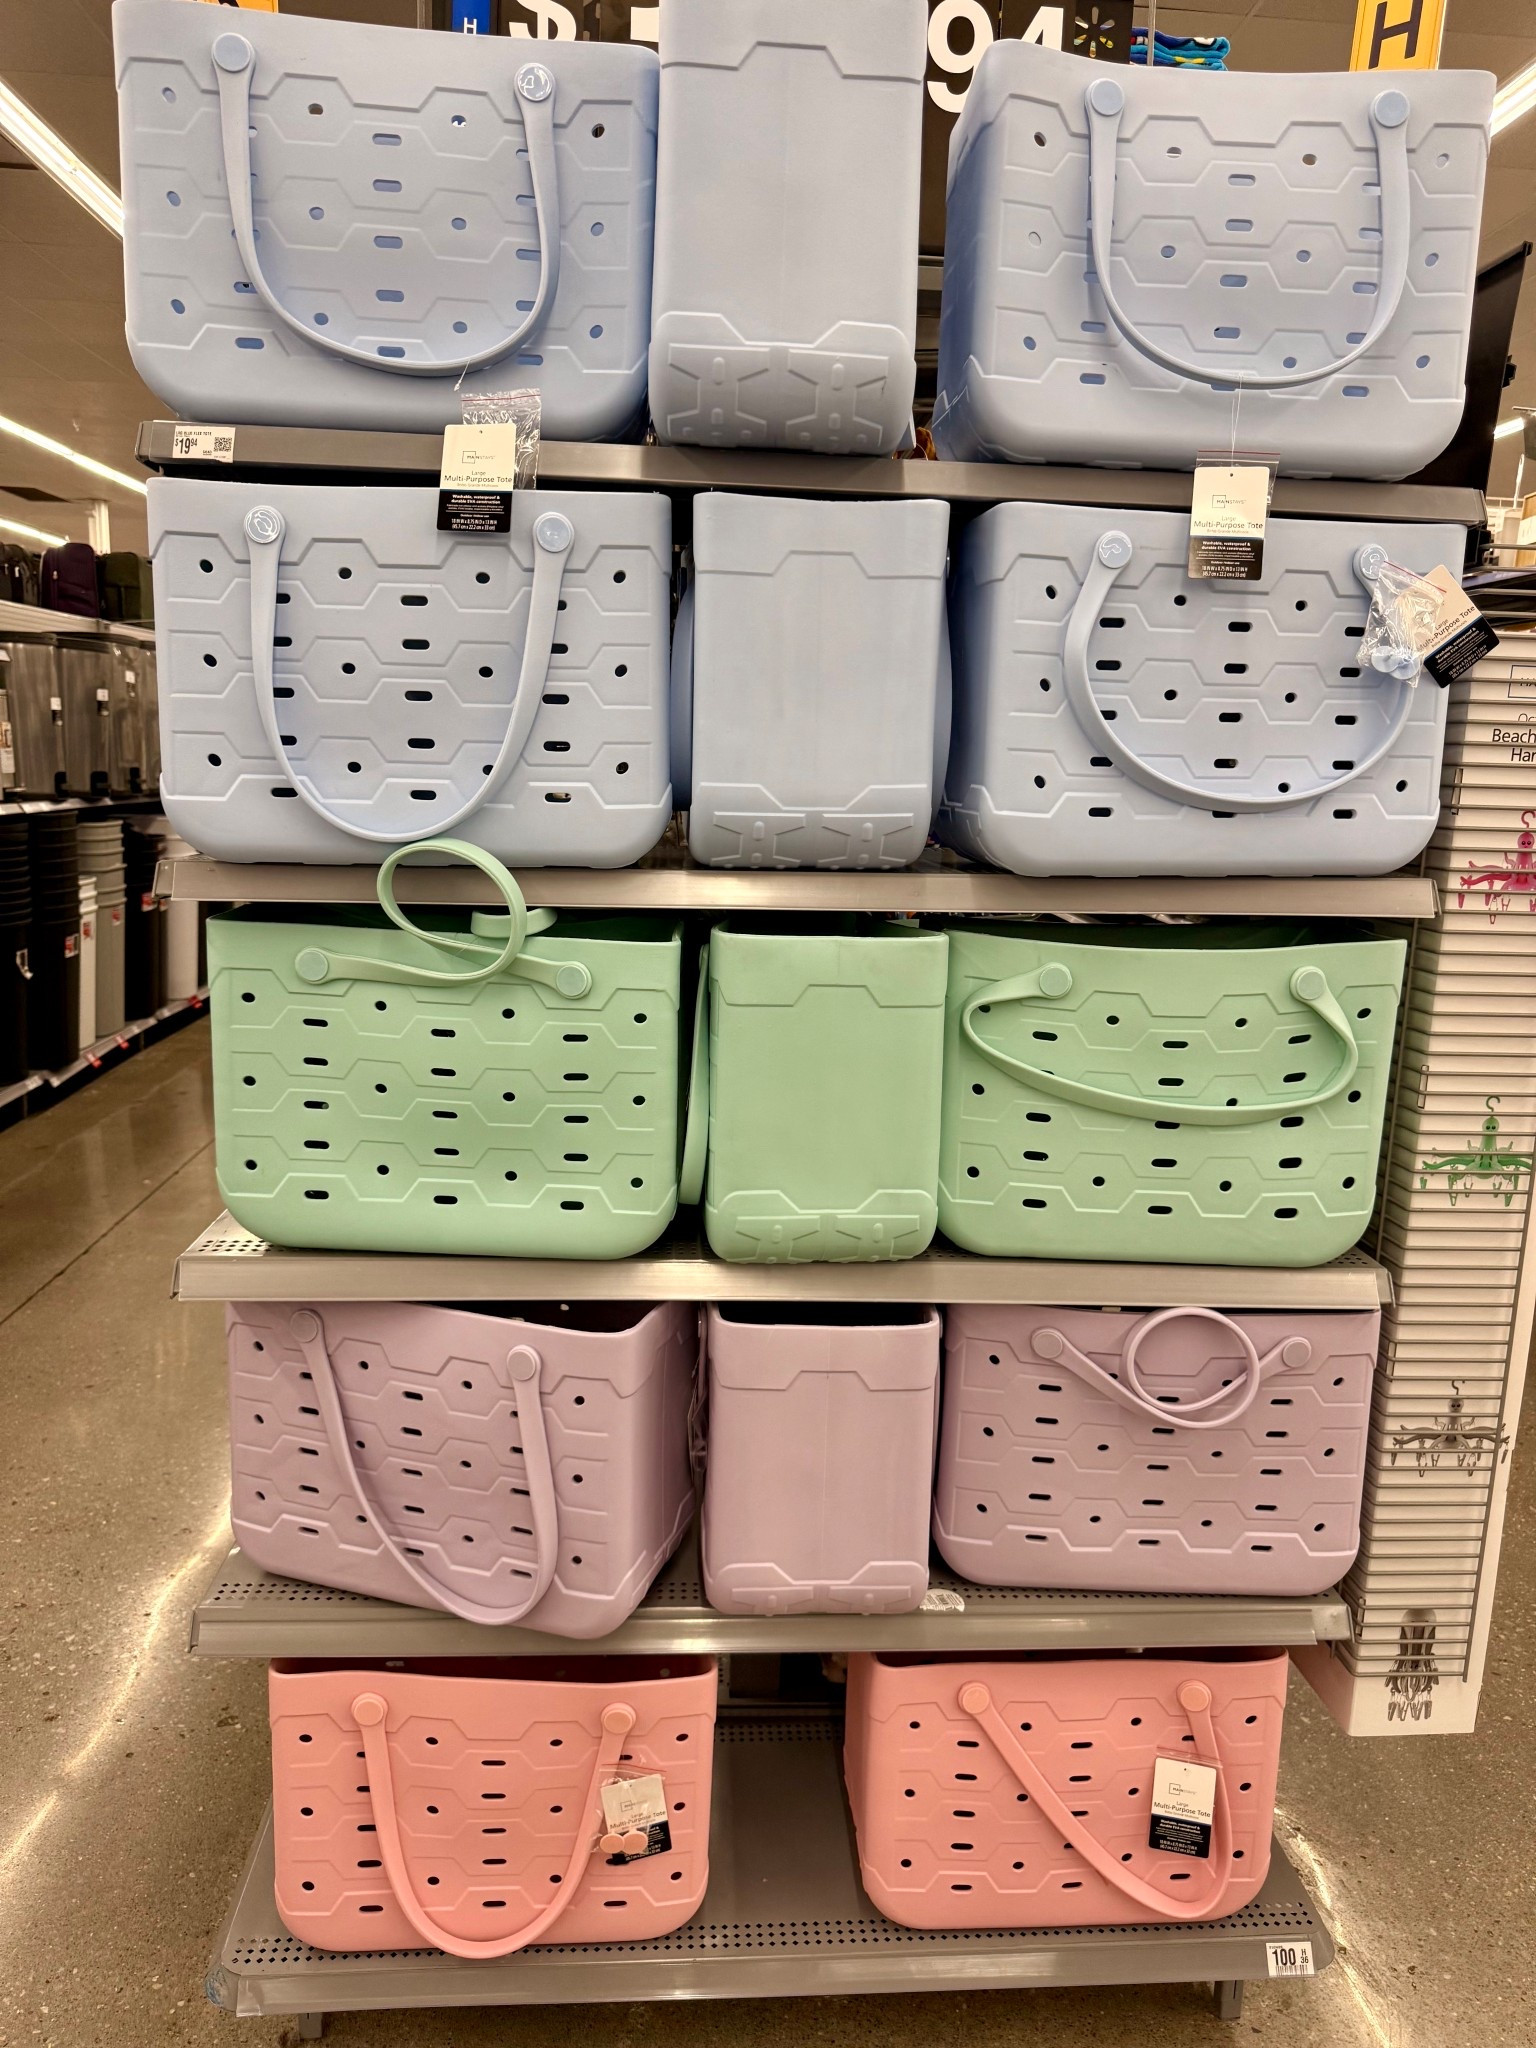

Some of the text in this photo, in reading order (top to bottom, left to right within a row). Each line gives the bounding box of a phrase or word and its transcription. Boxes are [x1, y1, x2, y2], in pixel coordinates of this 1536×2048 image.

[1368, 0, 1424, 70] H
[1194, 521, 1245, 529] Multi-Purpose
[1460, 606, 1475, 619] Tote
[1492, 728, 1536, 743] Beach
[1197, 1809, 1211, 1817] Tote
[1272, 1948, 1296, 1966] 100
